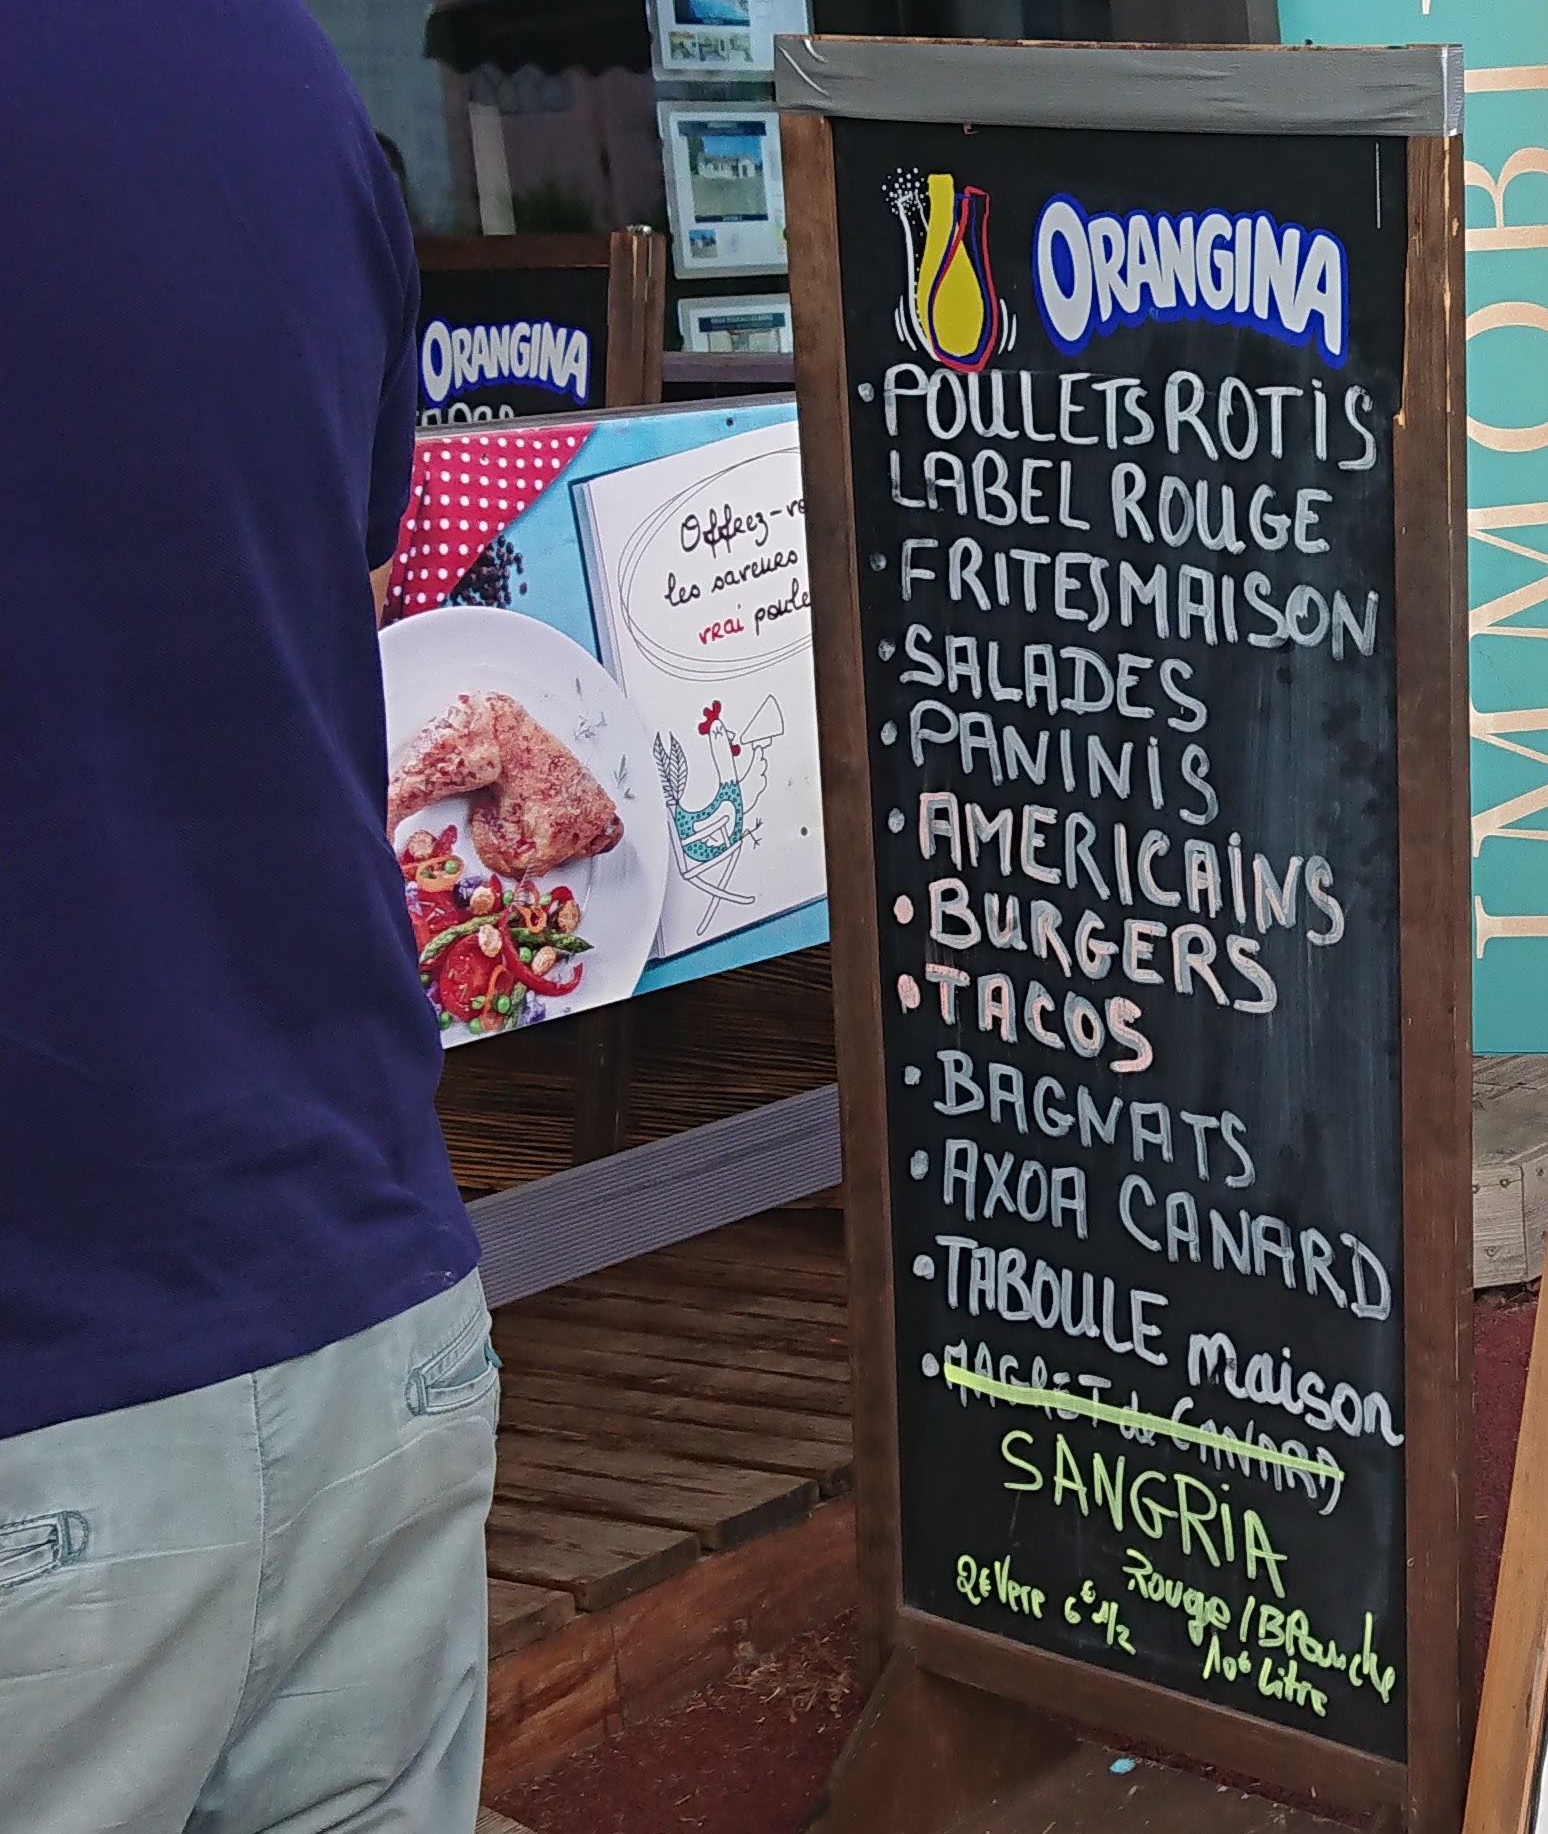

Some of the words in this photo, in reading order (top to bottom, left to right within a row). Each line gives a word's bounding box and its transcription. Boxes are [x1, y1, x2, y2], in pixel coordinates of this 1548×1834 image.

[1034, 198, 1347, 359] ORANGINA
[421, 319, 589, 403] ORANGINA
[890, 449, 1090, 530] LABEL
[1112, 462, 1334, 555] ROUGE
[664, 572, 701, 607] les
[711, 549, 798, 594] saveurs
[699, 603, 745, 645] vrai
[901, 538, 1110, 634] FRITES
[1120, 562, 1380, 660] MAISON
[899, 624, 1208, 734] SALADES
[929, 877, 1278, 1014] BURGERS
[924, 964, 1154, 1073] TACOS
[933, 1049, 1256, 1188] BAGNATS
[941, 1138, 1087, 1240] AXOA
[1119, 1173, 1393, 1321] CANARD
[935, 1233, 1168, 1368] TABOULE
